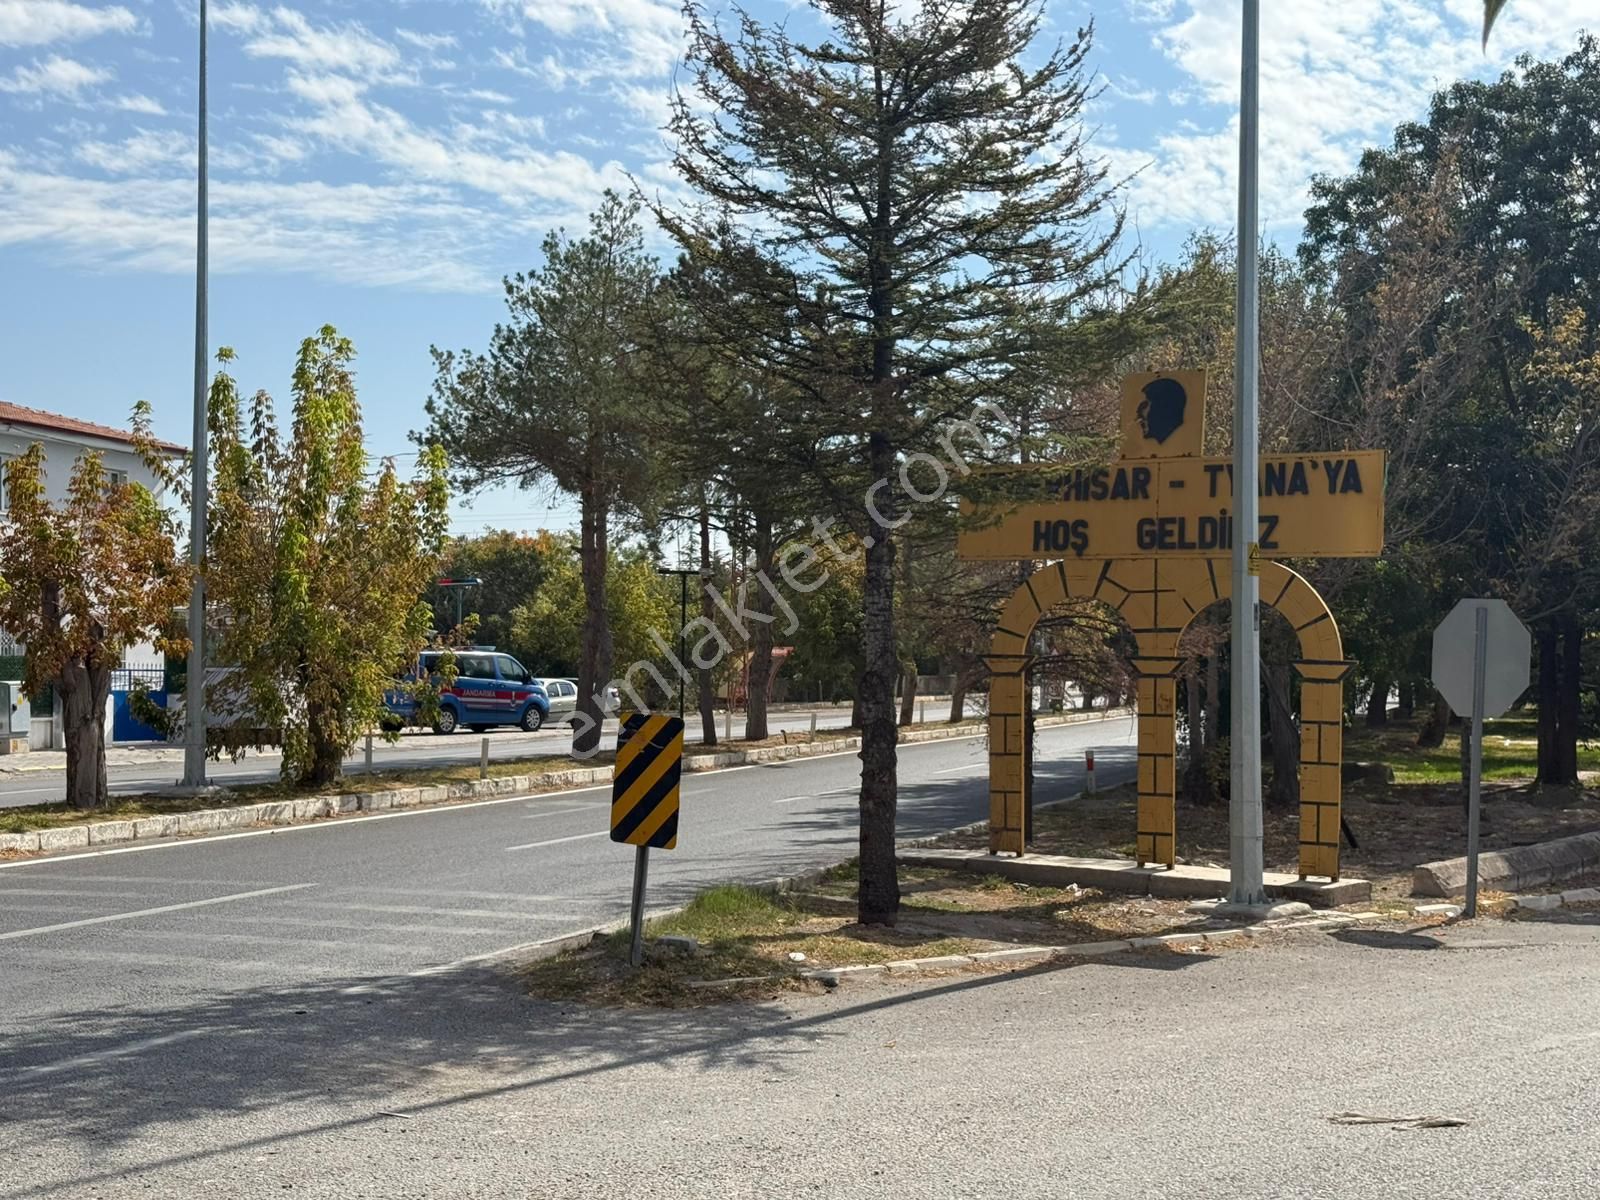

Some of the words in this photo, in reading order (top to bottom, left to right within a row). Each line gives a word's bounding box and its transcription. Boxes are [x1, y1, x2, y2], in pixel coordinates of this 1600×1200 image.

[1168, 480, 1185, 489] -
[1203, 458, 1363, 498] TNA'YA
[1032, 518, 1089, 558] HOŞ
[1136, 507, 1280, 551] GELDİZ
